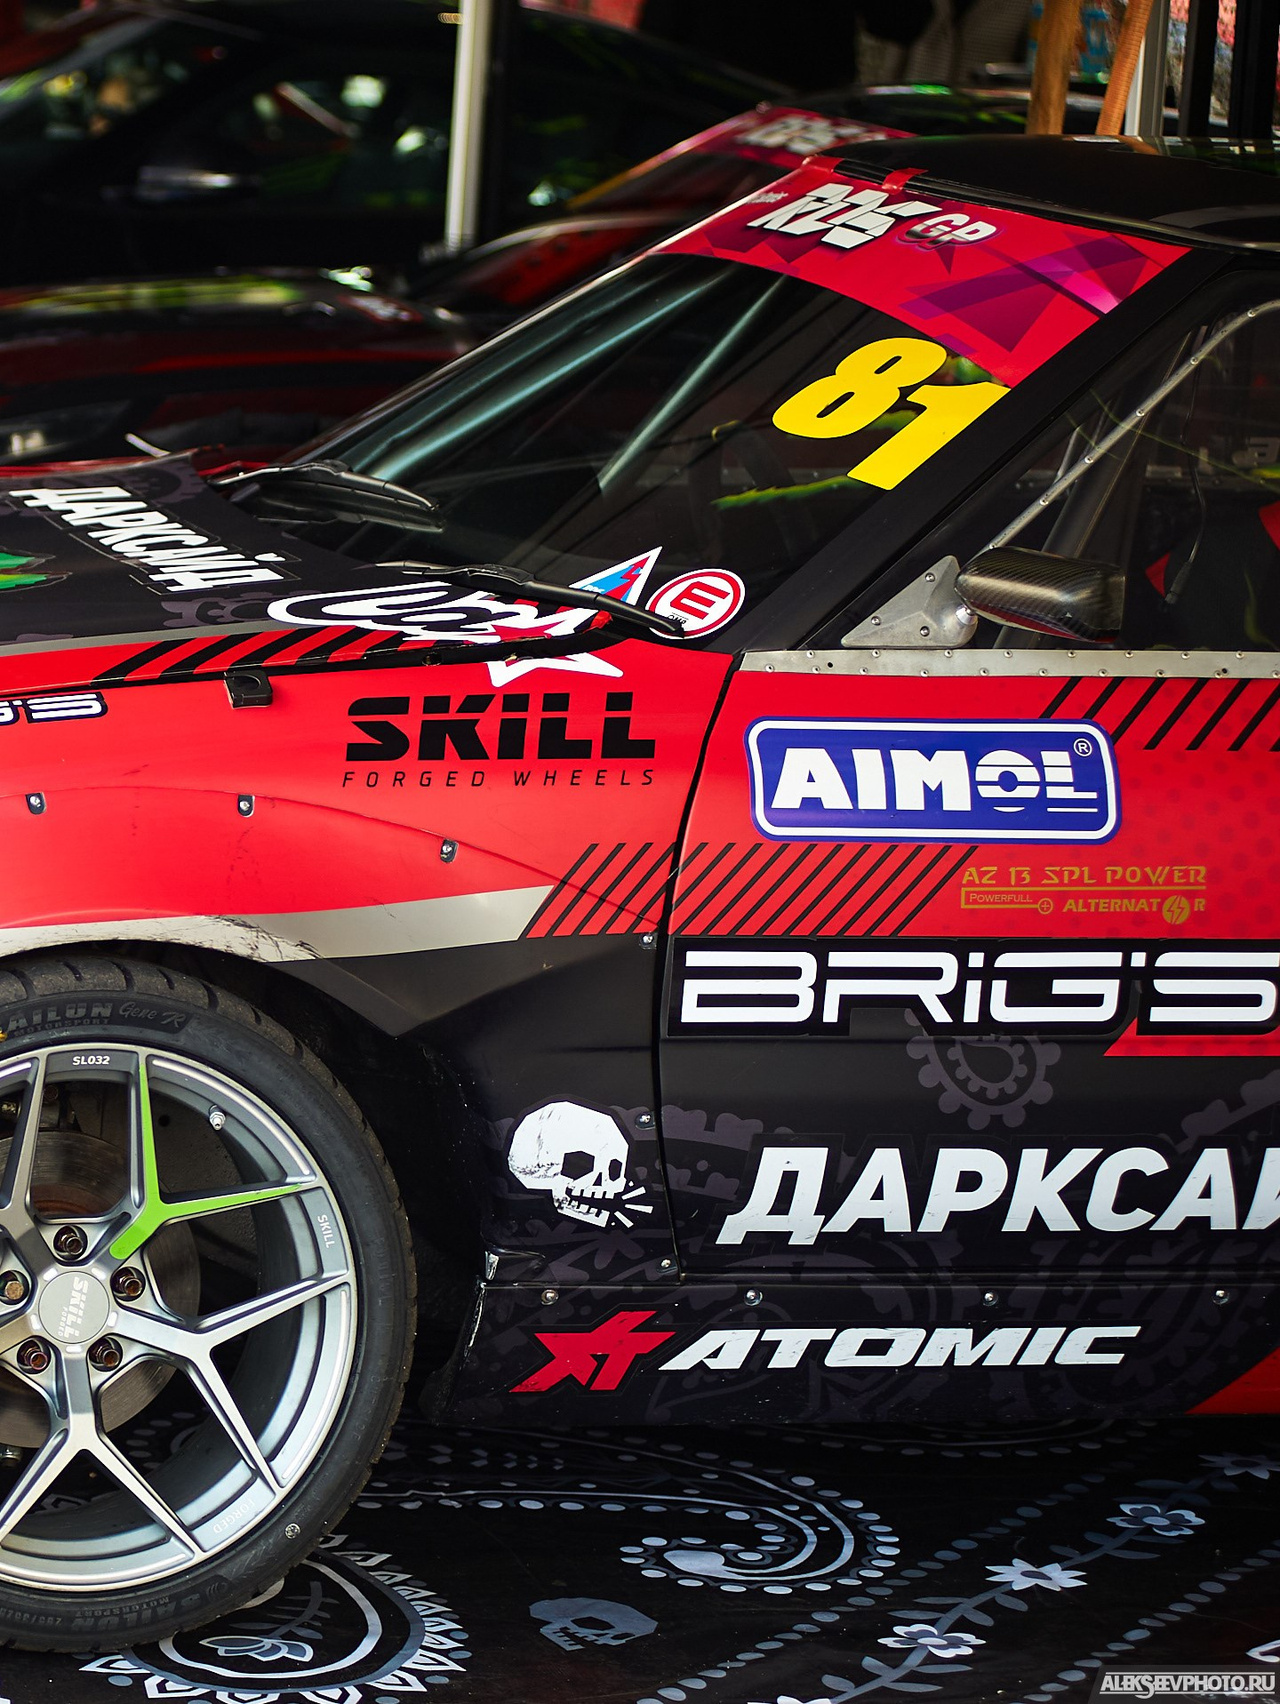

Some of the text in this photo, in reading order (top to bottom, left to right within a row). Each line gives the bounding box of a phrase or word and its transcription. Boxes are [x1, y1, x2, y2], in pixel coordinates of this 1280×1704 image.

[772, 337, 1012, 491] 81
[9, 486, 286, 592] ДАРКСАЙД
[345, 692, 656, 762] SKILL
[342, 769, 654, 788] FORGED WHEELS
[962, 866, 998, 885] AZ
[1041, 866, 1097, 885] SPL
[1104, 865, 1207, 885] POWER
[72, 1055, 110, 1066] SL032
[317, 1214, 335, 1249] SKILL
[658, 1326, 1142, 1371] ATOMIC
